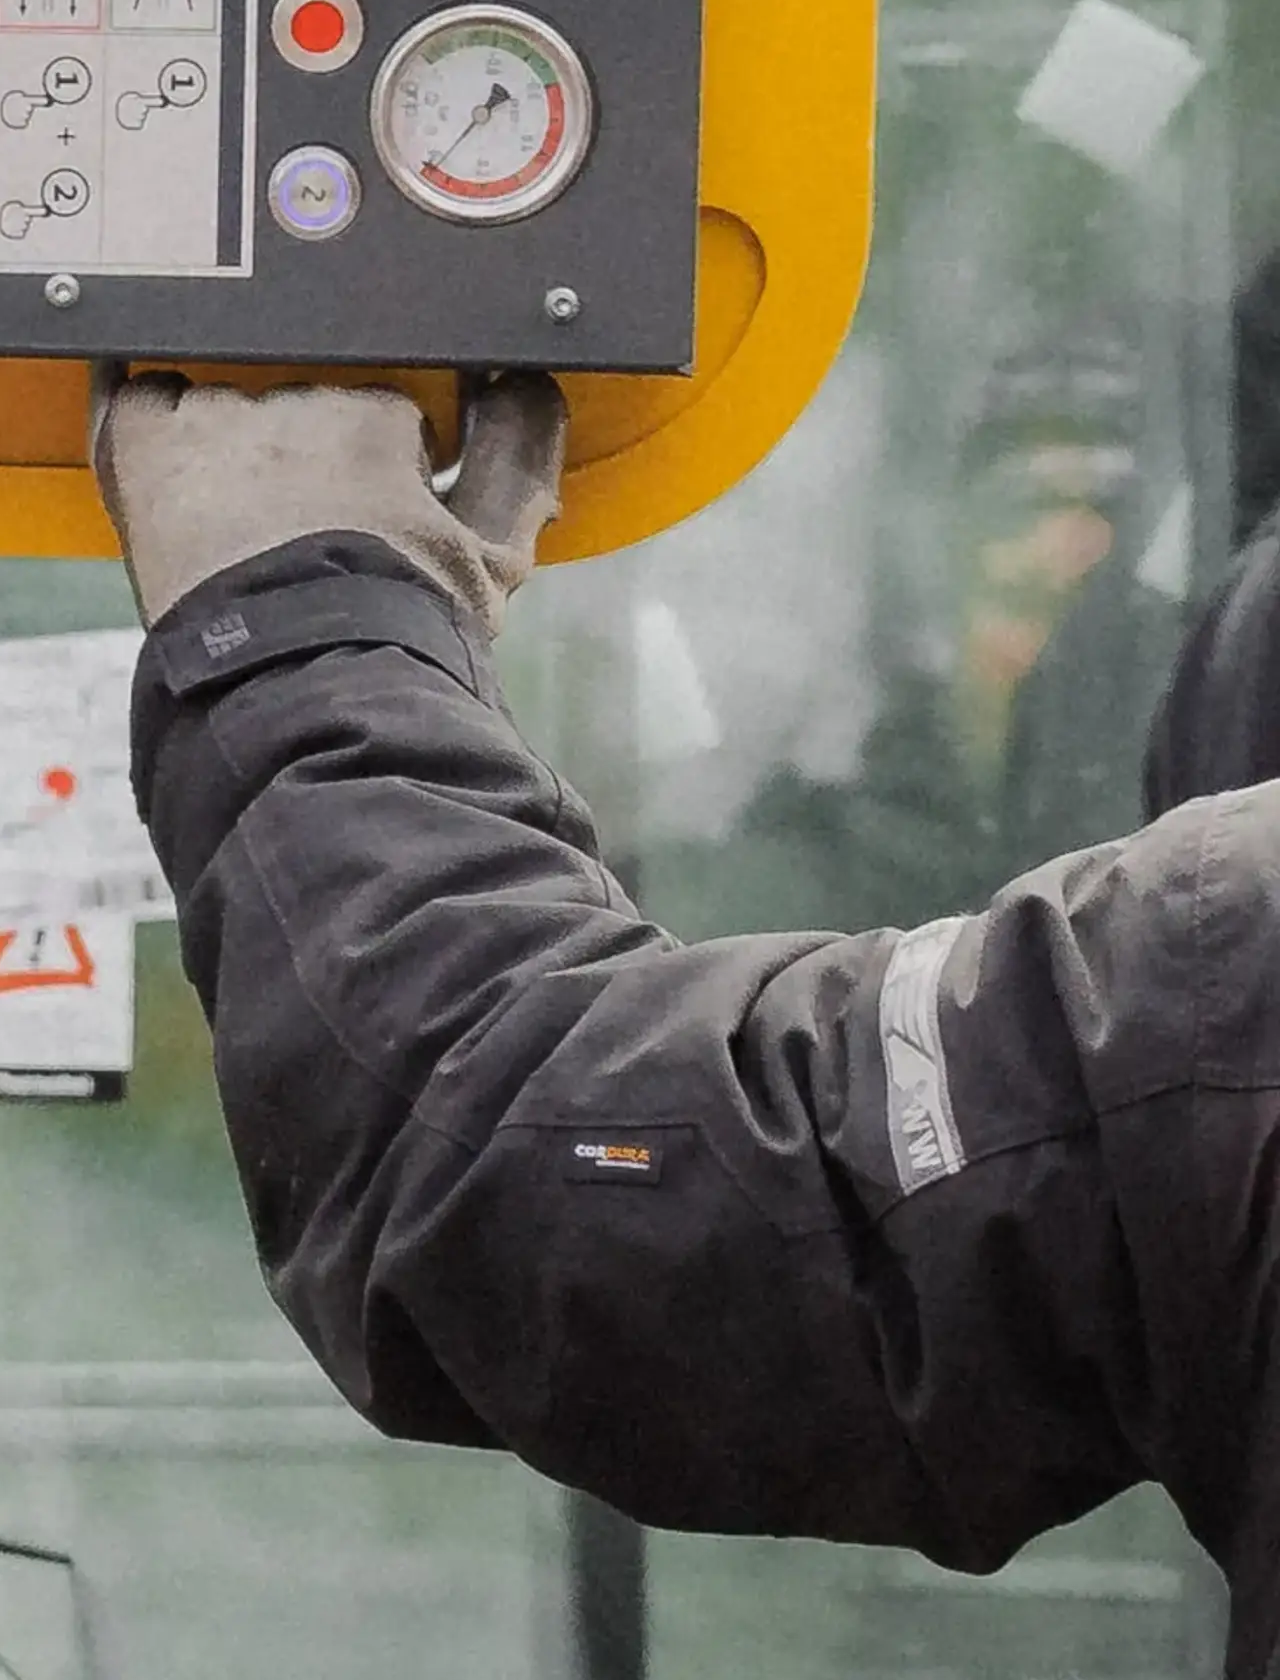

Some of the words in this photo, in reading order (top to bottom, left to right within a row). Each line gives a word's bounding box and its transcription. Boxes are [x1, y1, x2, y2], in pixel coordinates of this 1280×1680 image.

[55, 71, 80, 90] 1
[170, 73, 195, 92] 1
[53, 184, 79, 203] 2
